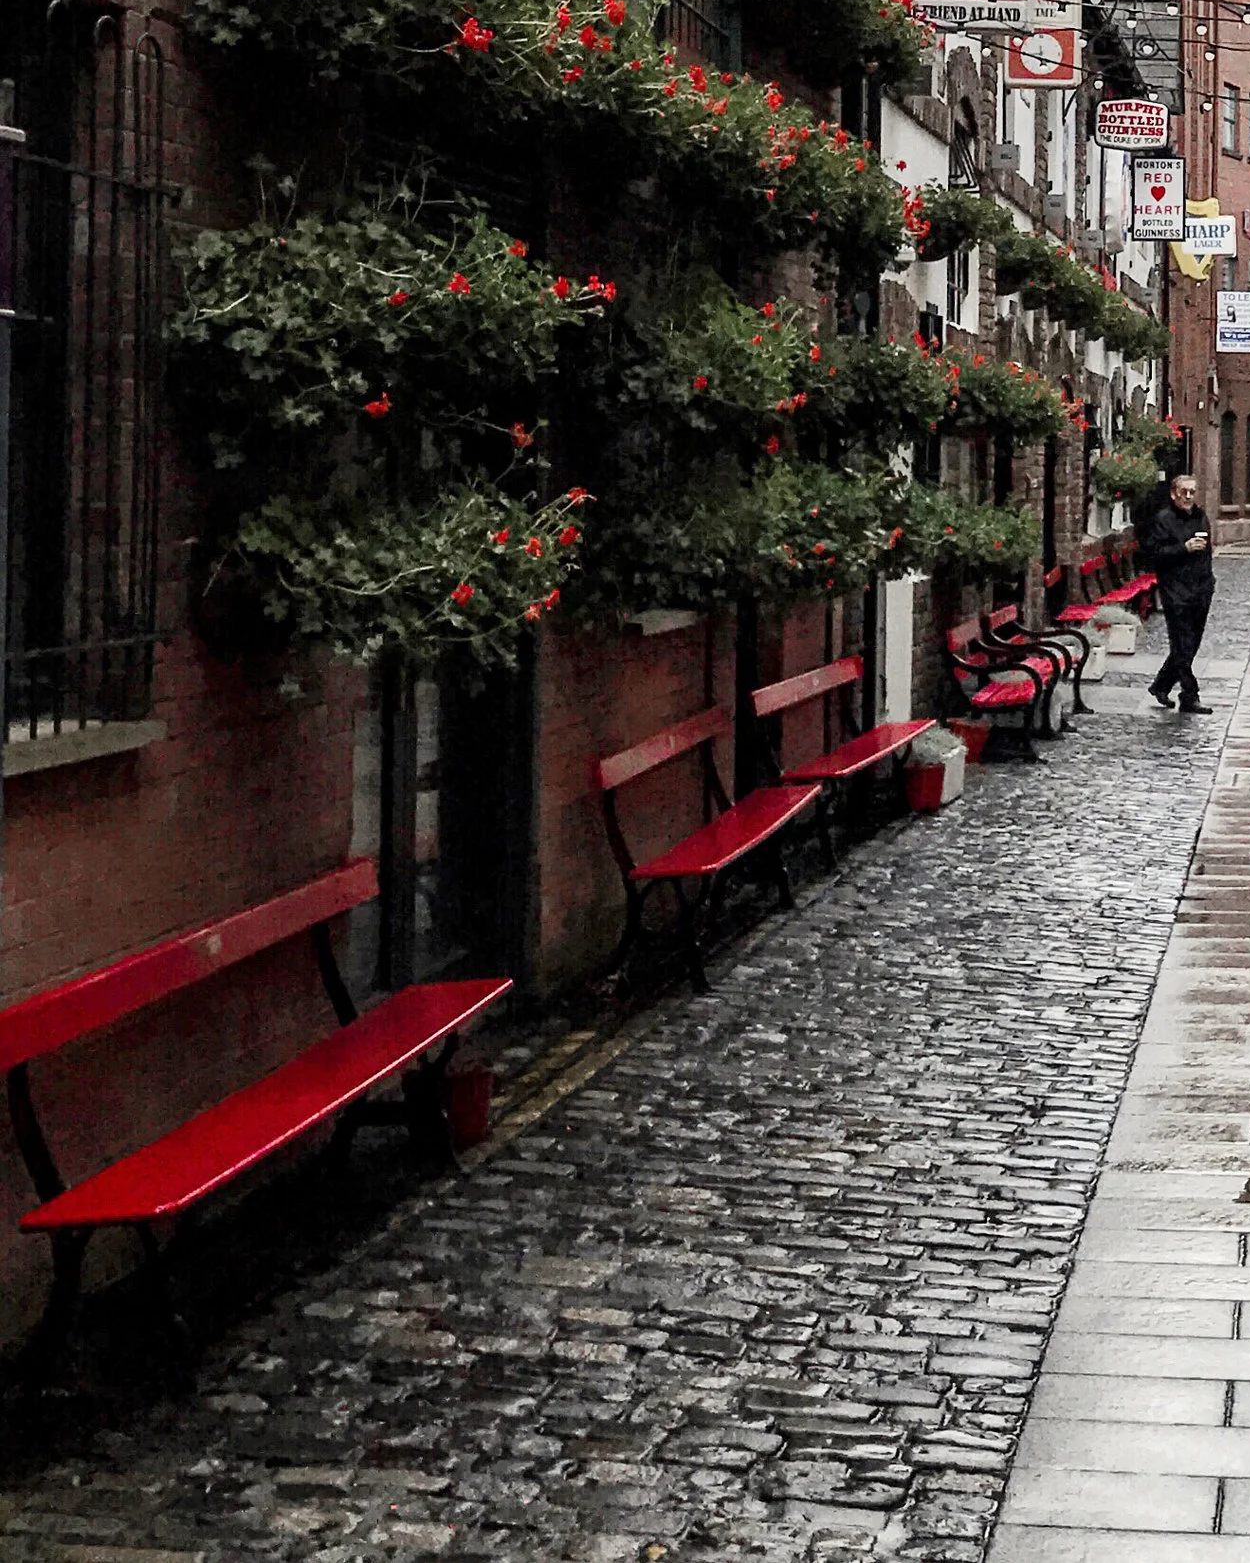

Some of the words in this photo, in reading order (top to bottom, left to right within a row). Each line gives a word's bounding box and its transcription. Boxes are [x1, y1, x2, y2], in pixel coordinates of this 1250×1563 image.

[969, 7, 985, 21] AT
[986, 8, 1020, 22] HAND
[1101, 102, 1164, 115] MURPHY
[1098, 114, 1164, 126] BOTTLED
[1098, 125, 1164, 136] GUINNESS
[1136, 161, 1181, 169] MORTON'S
[1144, 173, 1173, 183] RED
[1134, 205, 1181, 215] HEART
[1142, 219, 1173, 227] BOTTLED
[1135, 229, 1181, 237] GUINNESS
[1185, 224, 1231, 239] HARP
[1194, 240, 1222, 248] LAGER
[1223, 293, 1236, 301] TO
